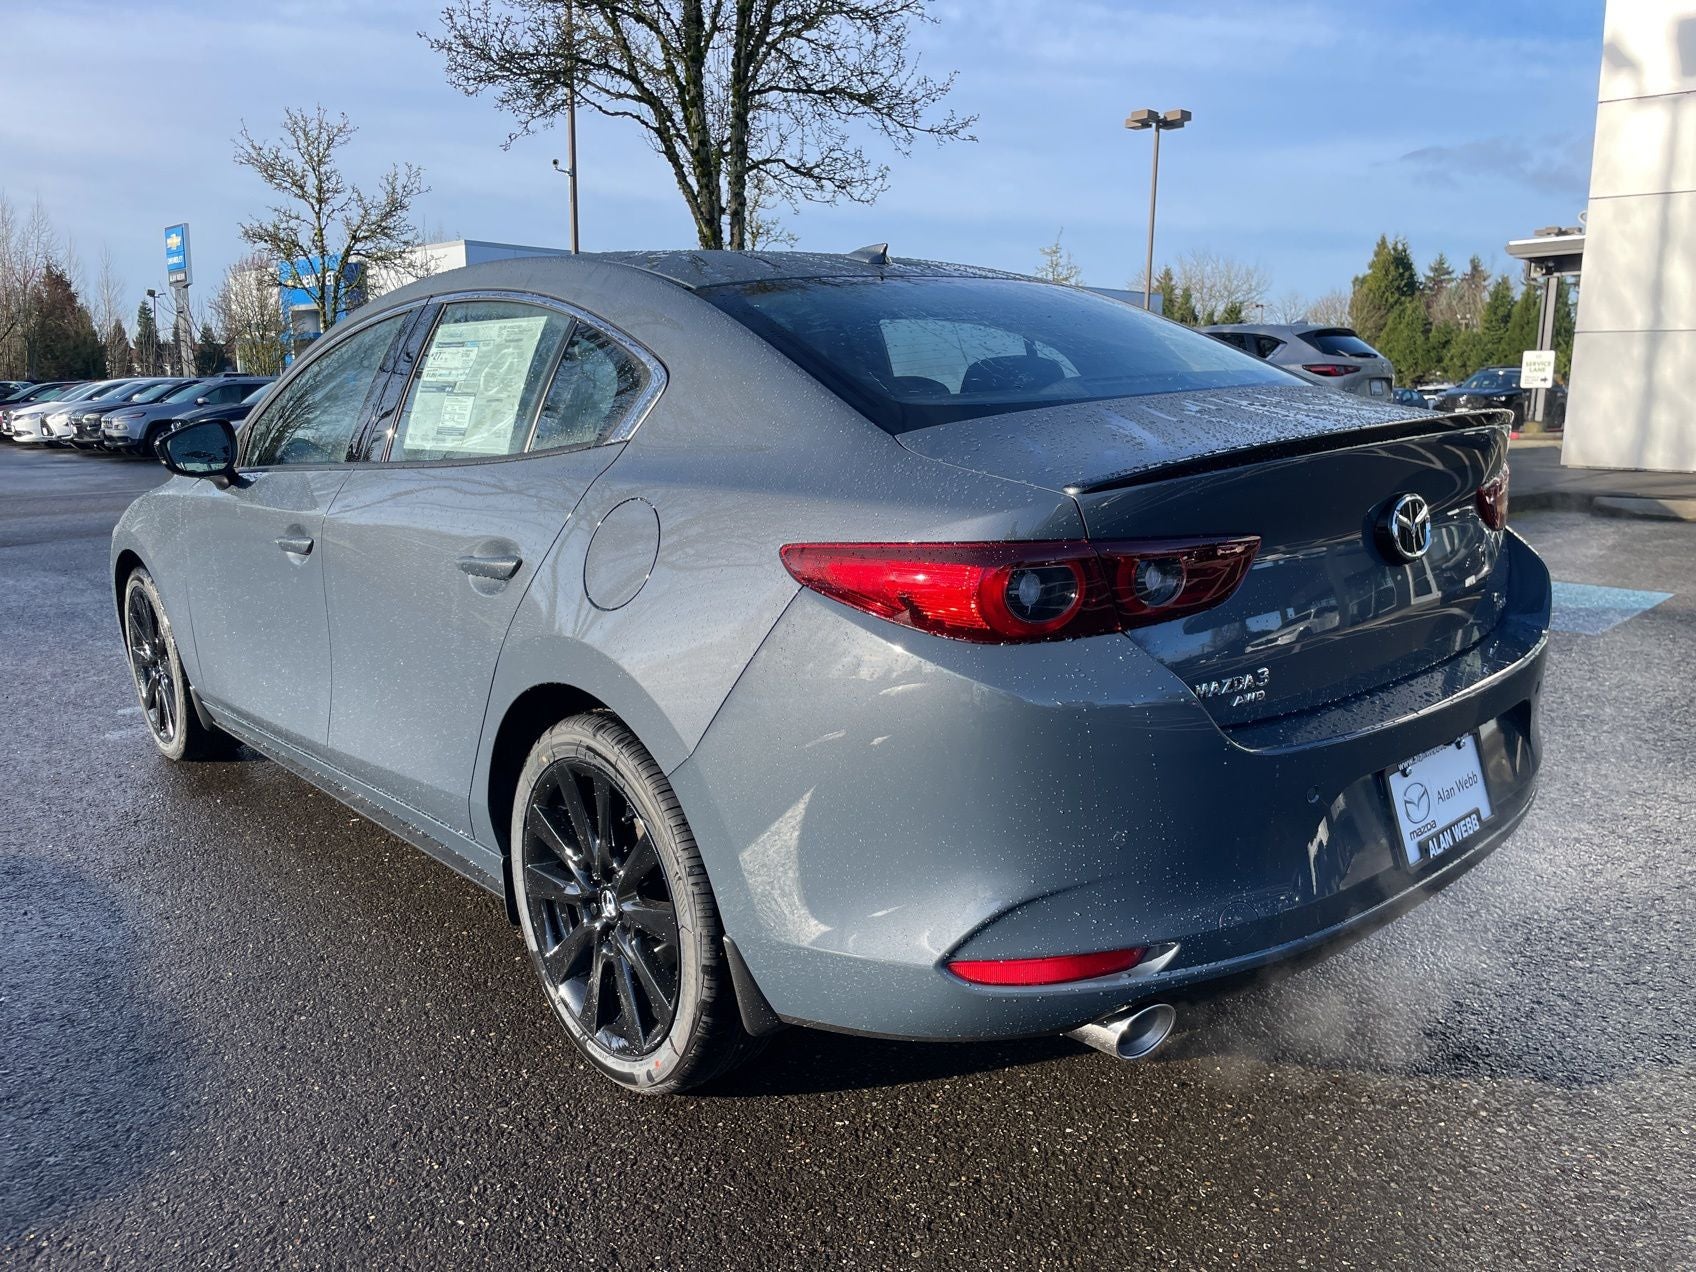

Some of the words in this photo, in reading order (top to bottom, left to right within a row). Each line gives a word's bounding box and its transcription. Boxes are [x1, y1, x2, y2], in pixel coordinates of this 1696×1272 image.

[1195, 667, 1270, 699] MAZDA3
[1232, 689, 1265, 707] AWD
[1437, 786, 1456, 805] Alan
[1455, 771, 1478, 792] Webb
[1428, 828, 1453, 859] ALAN
[1452, 813, 1480, 842] WEBB
